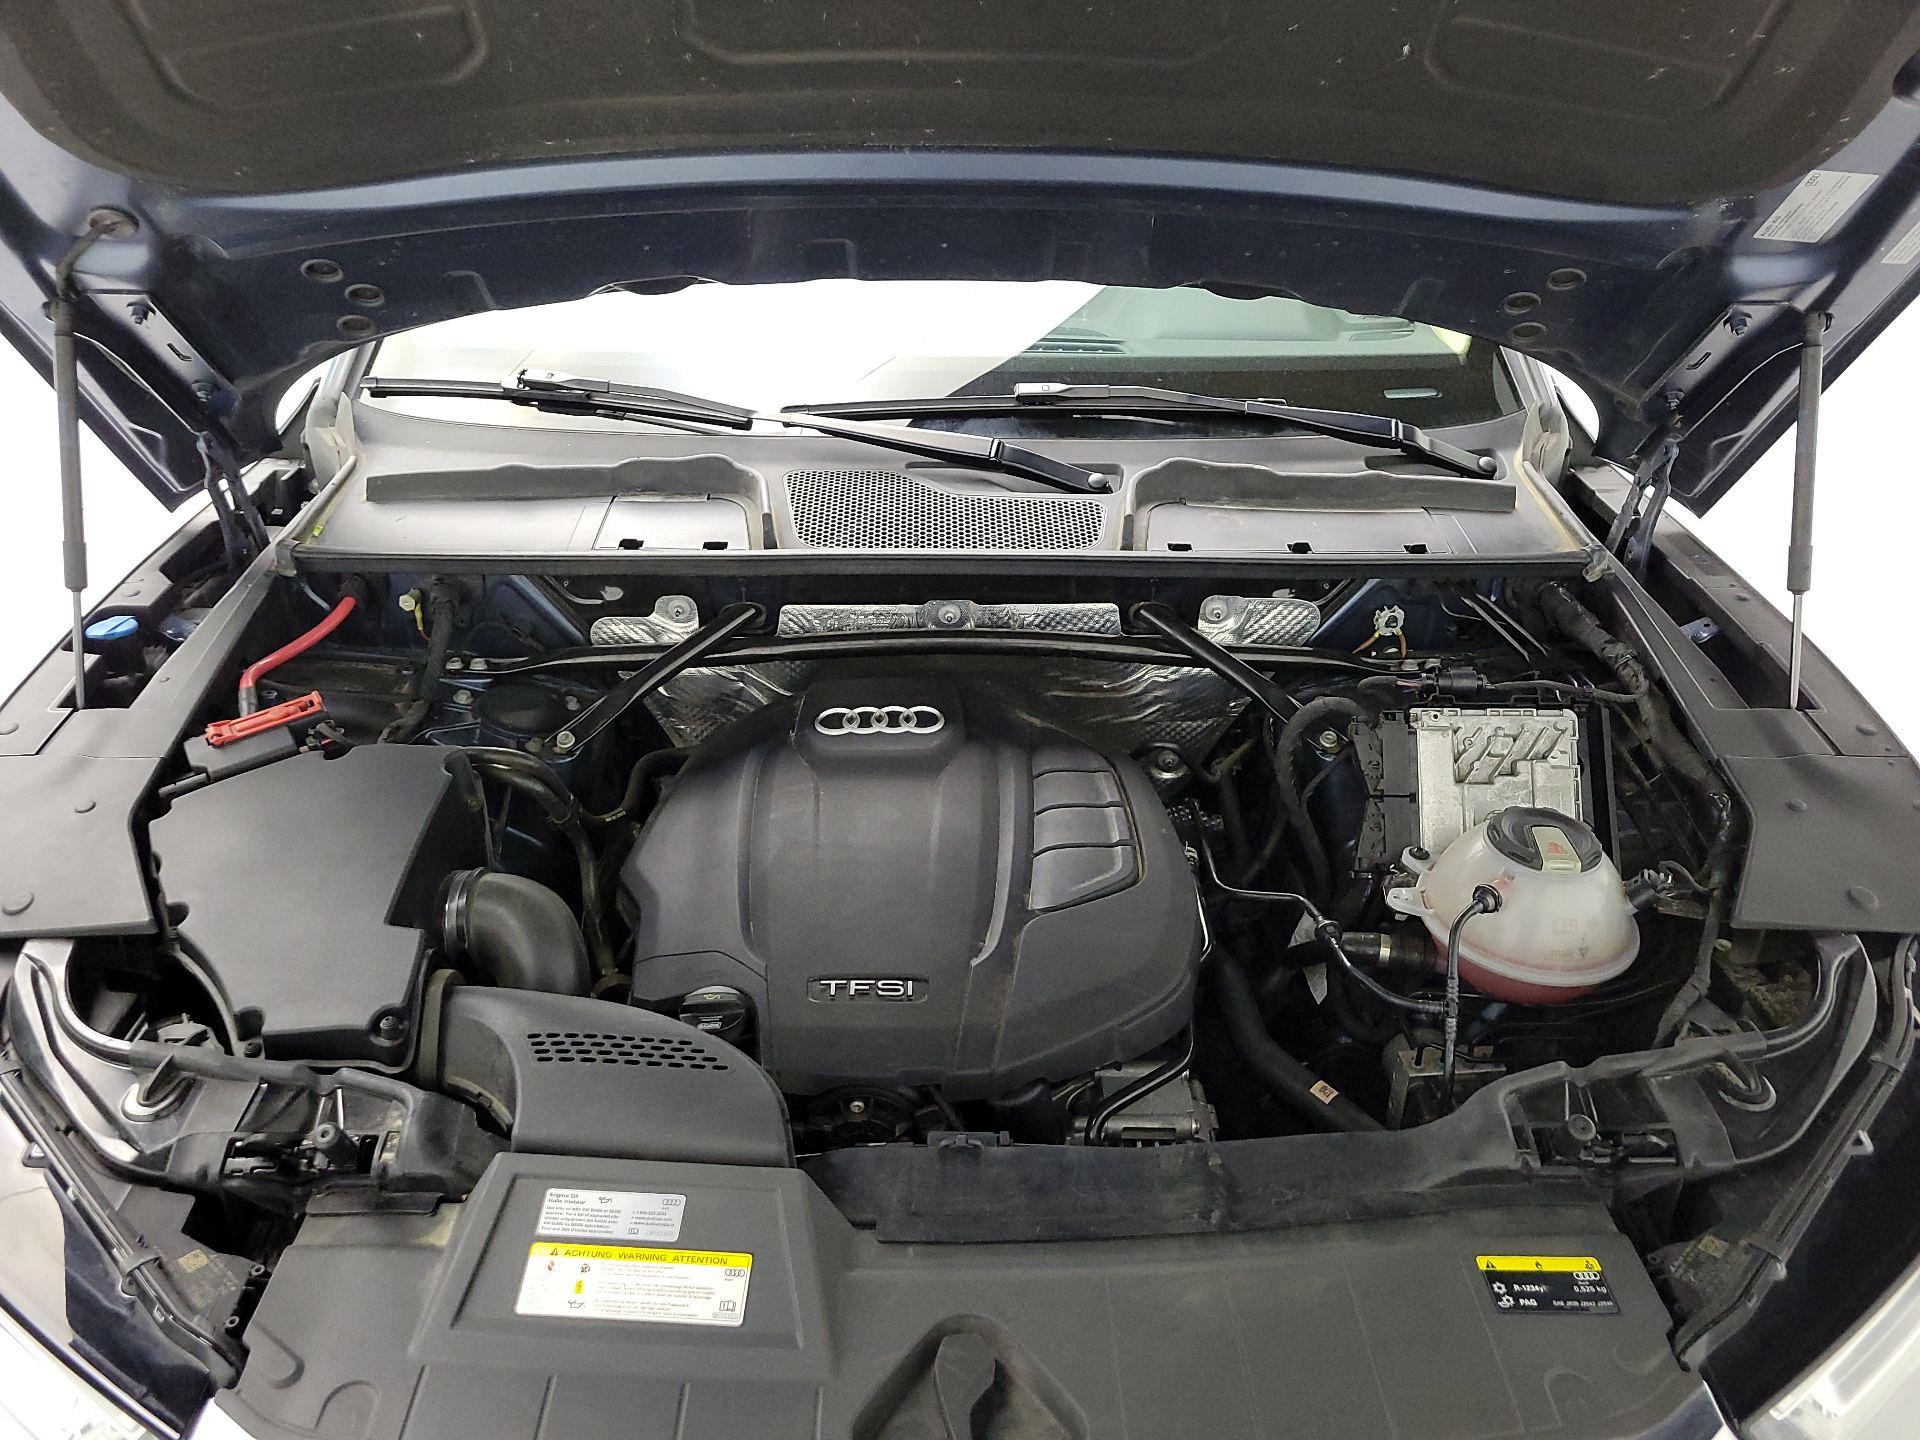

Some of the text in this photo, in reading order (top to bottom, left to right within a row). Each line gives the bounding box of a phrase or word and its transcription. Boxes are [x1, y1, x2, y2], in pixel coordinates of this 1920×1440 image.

[820, 980, 913, 997] TFSI
[564, 1248, 728, 1265] ACHTUNG WARNING ATTENTION
[1519, 1298, 1538, 1306] PAG
